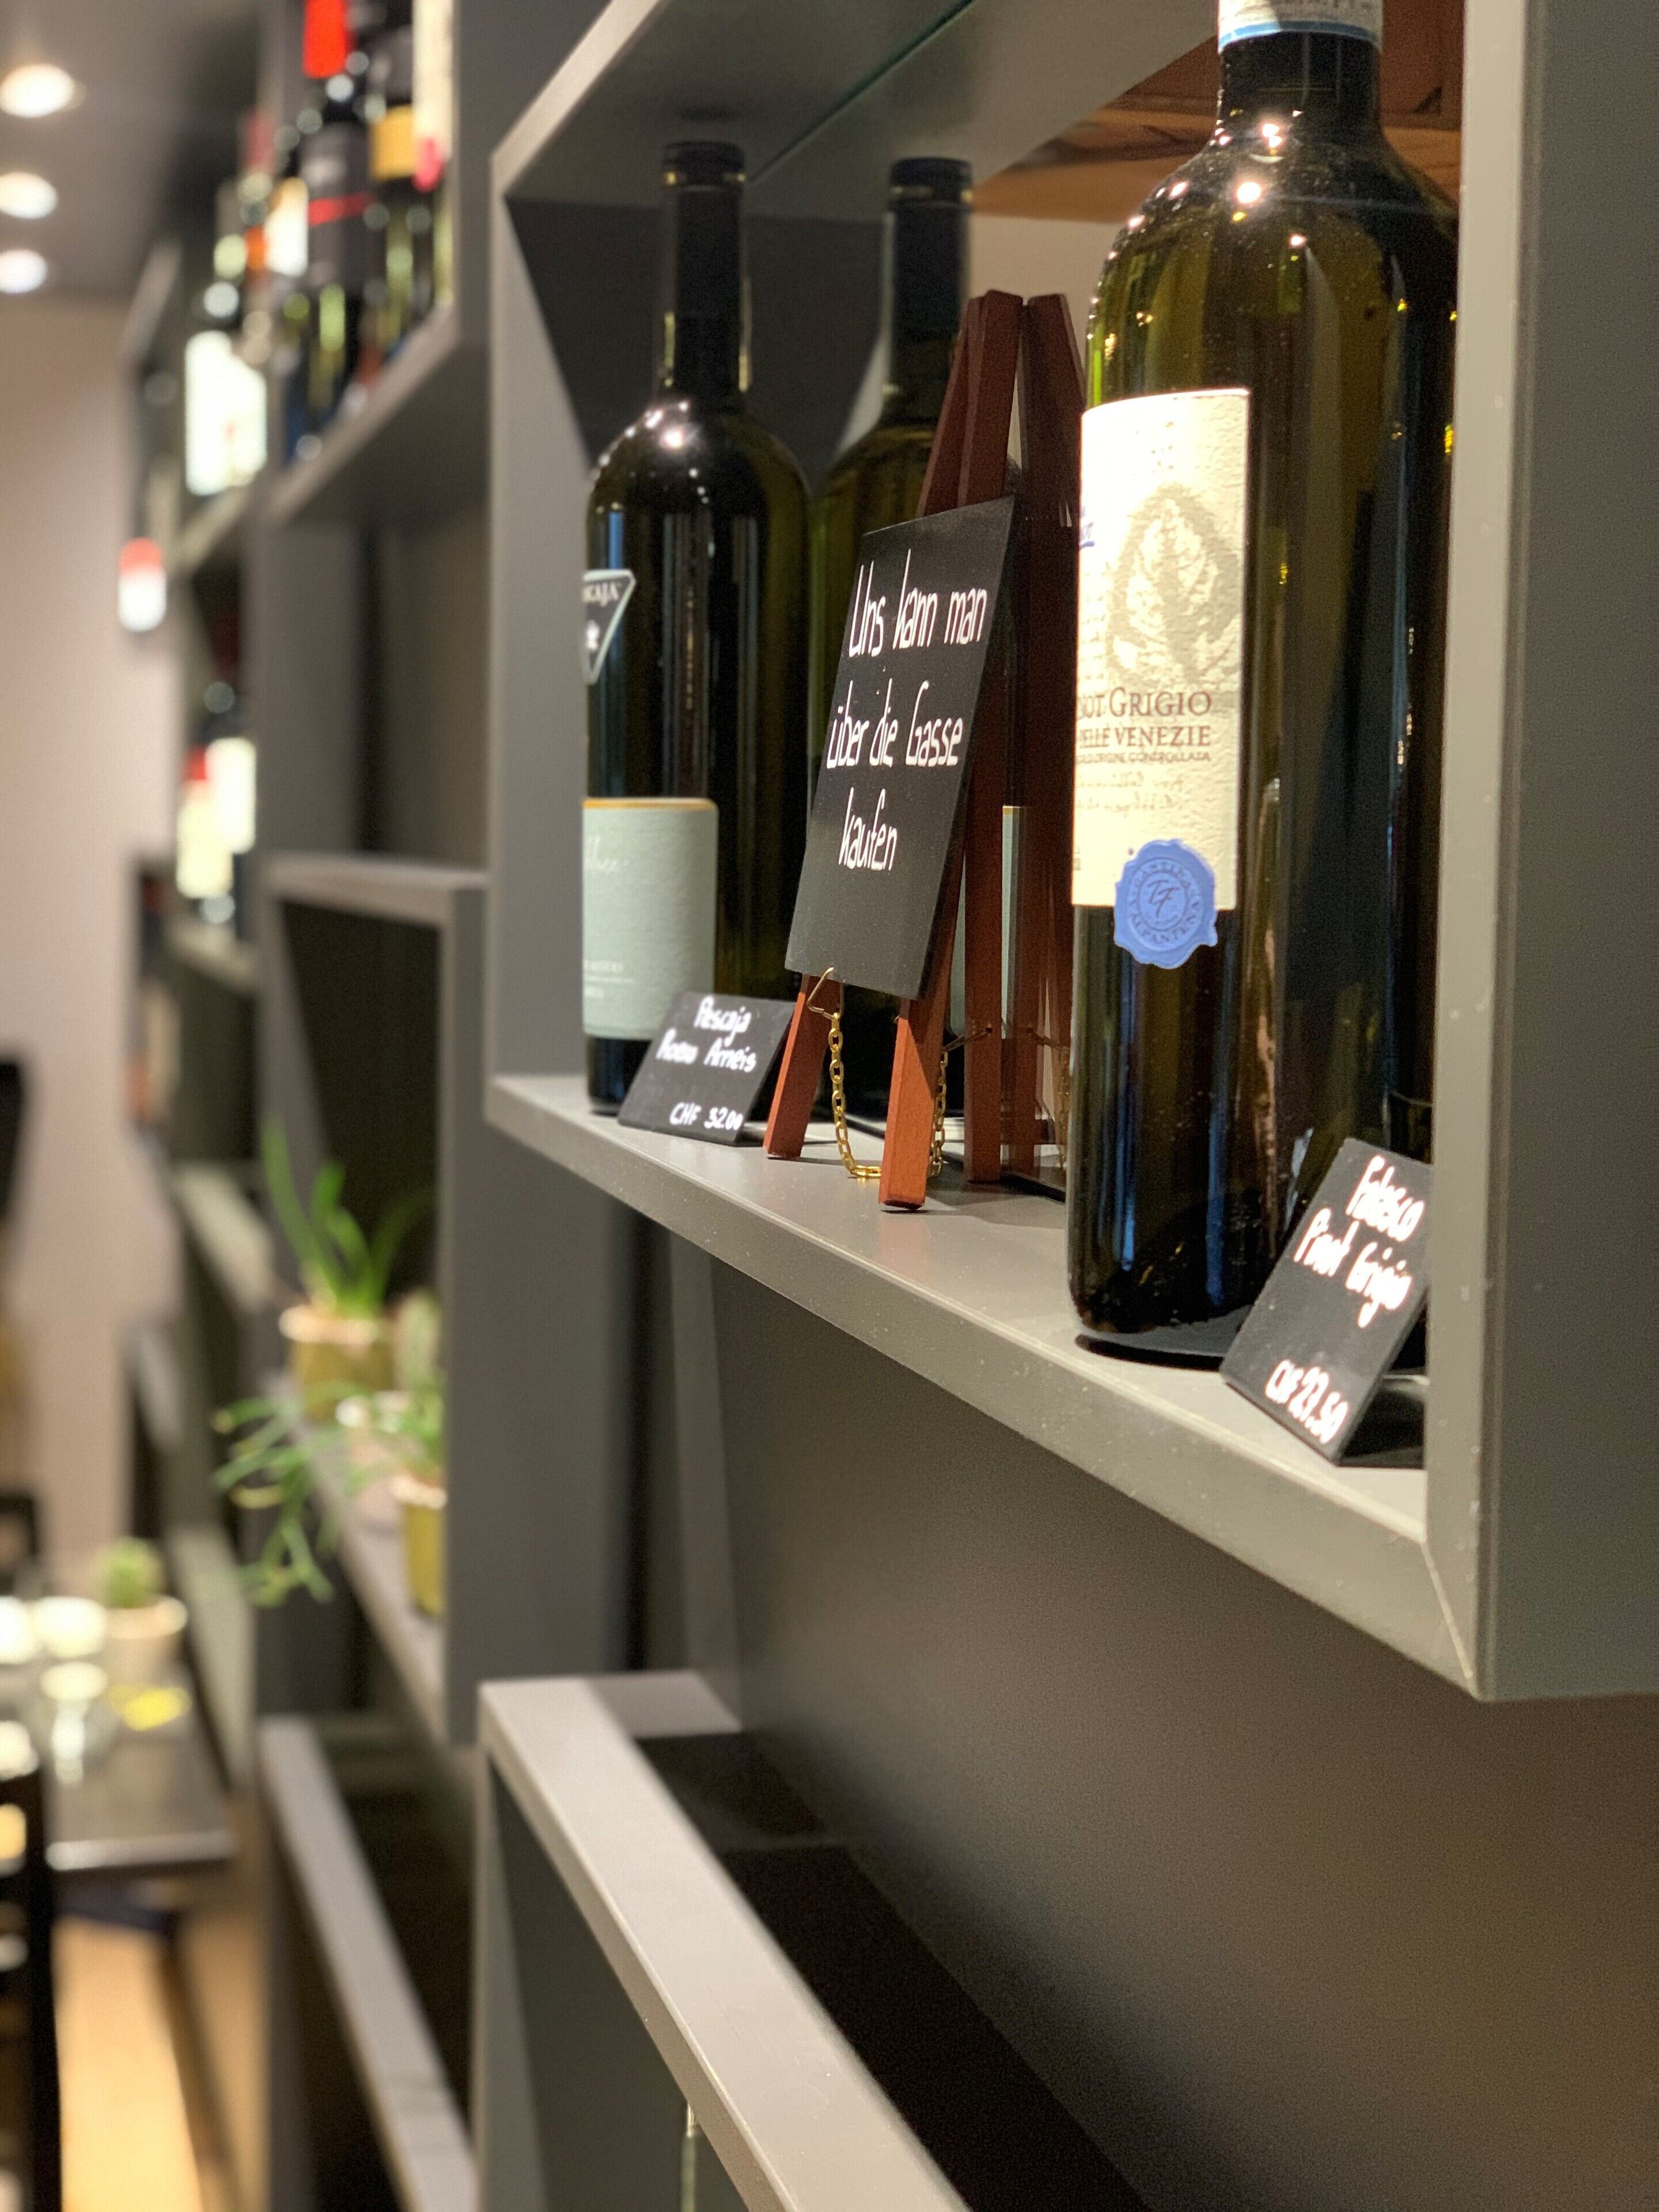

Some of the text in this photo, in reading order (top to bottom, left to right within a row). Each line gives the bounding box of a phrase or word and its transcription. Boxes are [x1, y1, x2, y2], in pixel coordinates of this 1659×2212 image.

[849, 548, 987, 657] Uns kann man
[827, 678, 964, 768] über die Gasse
[1109, 687, 1212, 718] GRIGIO
[1114, 726, 1211, 747] VENEZIE
[838, 787, 898, 871] kaufen
[669, 1102, 702, 1126] CHF
